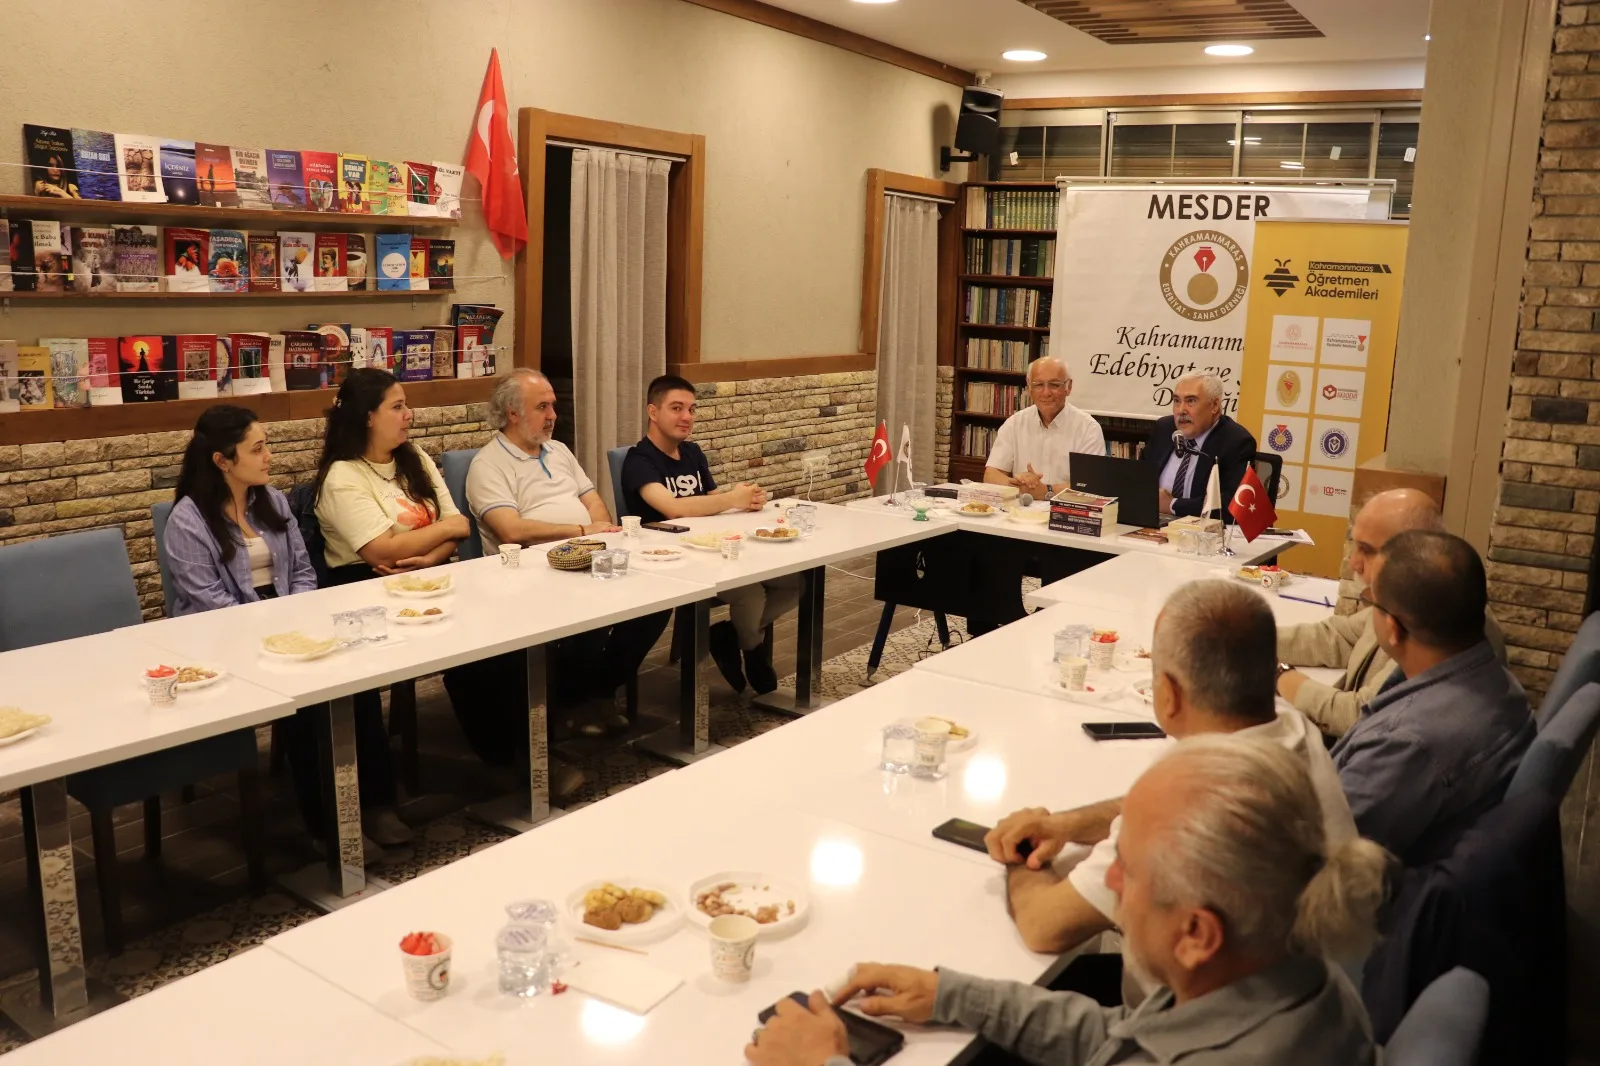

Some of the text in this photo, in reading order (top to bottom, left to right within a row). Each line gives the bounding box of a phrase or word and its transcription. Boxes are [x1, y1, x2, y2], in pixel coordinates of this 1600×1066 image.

[1147, 194, 1271, 221] MESDER
[1168, 232, 1244, 262] KAHRAMANMARAŞ
[1306, 271, 1369, 287] Öğretmen
[1309, 261, 1374, 273] Kahramanmaraş
[1162, 283, 1247, 320] EDEBİYAT SANAT DERNEĞİ
[1304, 285, 1379, 300] Akademileri
[1116, 325, 1245, 352] Kahramanm
